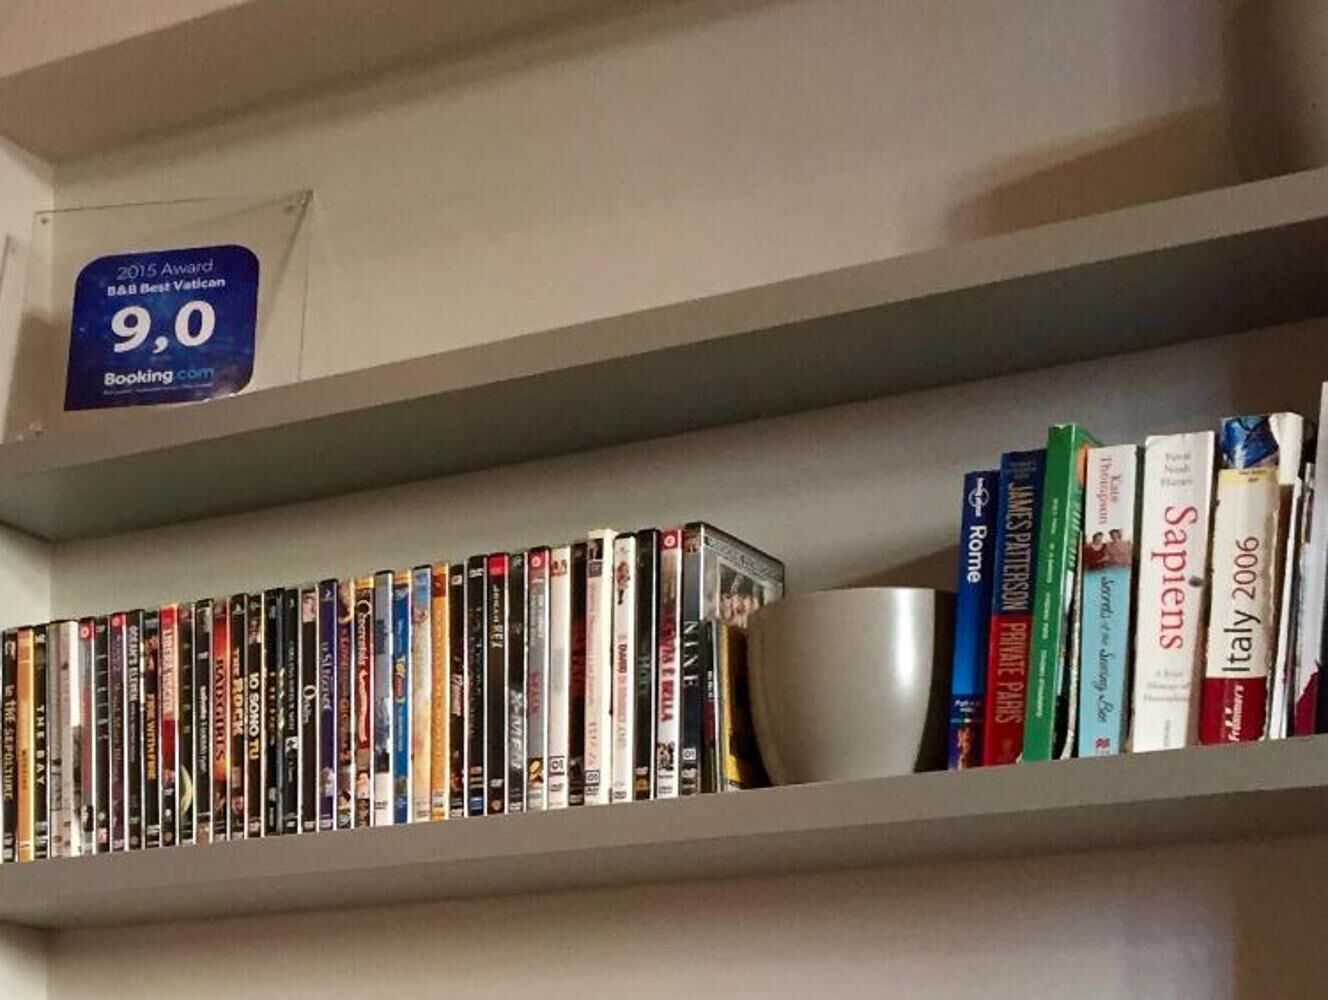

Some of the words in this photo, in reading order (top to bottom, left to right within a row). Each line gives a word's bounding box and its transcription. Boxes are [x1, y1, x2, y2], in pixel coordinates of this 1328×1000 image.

[107, 284, 138, 296] B&B
[140, 281, 171, 294] Best
[173, 278, 226, 291] Vatican
[116, 263, 157, 280] 2015
[161, 258, 213, 275] Award
[112, 300, 216, 354] 9,0
[104, 367, 215, 386] Booking.com
[1005, 481, 1035, 531] JAMES
[1098, 456, 1113, 525] Thompson
[1109, 475, 1123, 503] Kate
[966, 525, 987, 584] Rome
[1001, 533, 1033, 611] PATTERSON
[1151, 505, 1199, 651] Sapiens
[1231, 535, 1261, 601] 2006
[1100, 576, 1116, 620] Secrets
[683, 620, 699, 688] NINE
[997, 622, 1027, 676] PRIVATE
[1222, 606, 1262, 673] Italy
[248, 673, 260, 689] IO
[661, 682, 675, 724] BELLA
[995, 682, 1025, 724] PARIS
[35, 704, 46, 739] THE
[232, 677, 245, 737] ROCK
[248, 692, 260, 738] SONO
[509, 689, 523, 770] X-MEN
[1227, 684, 1245, 743] Frommer's
[35, 749, 46, 786] BAY
[248, 739, 260, 760] TU
